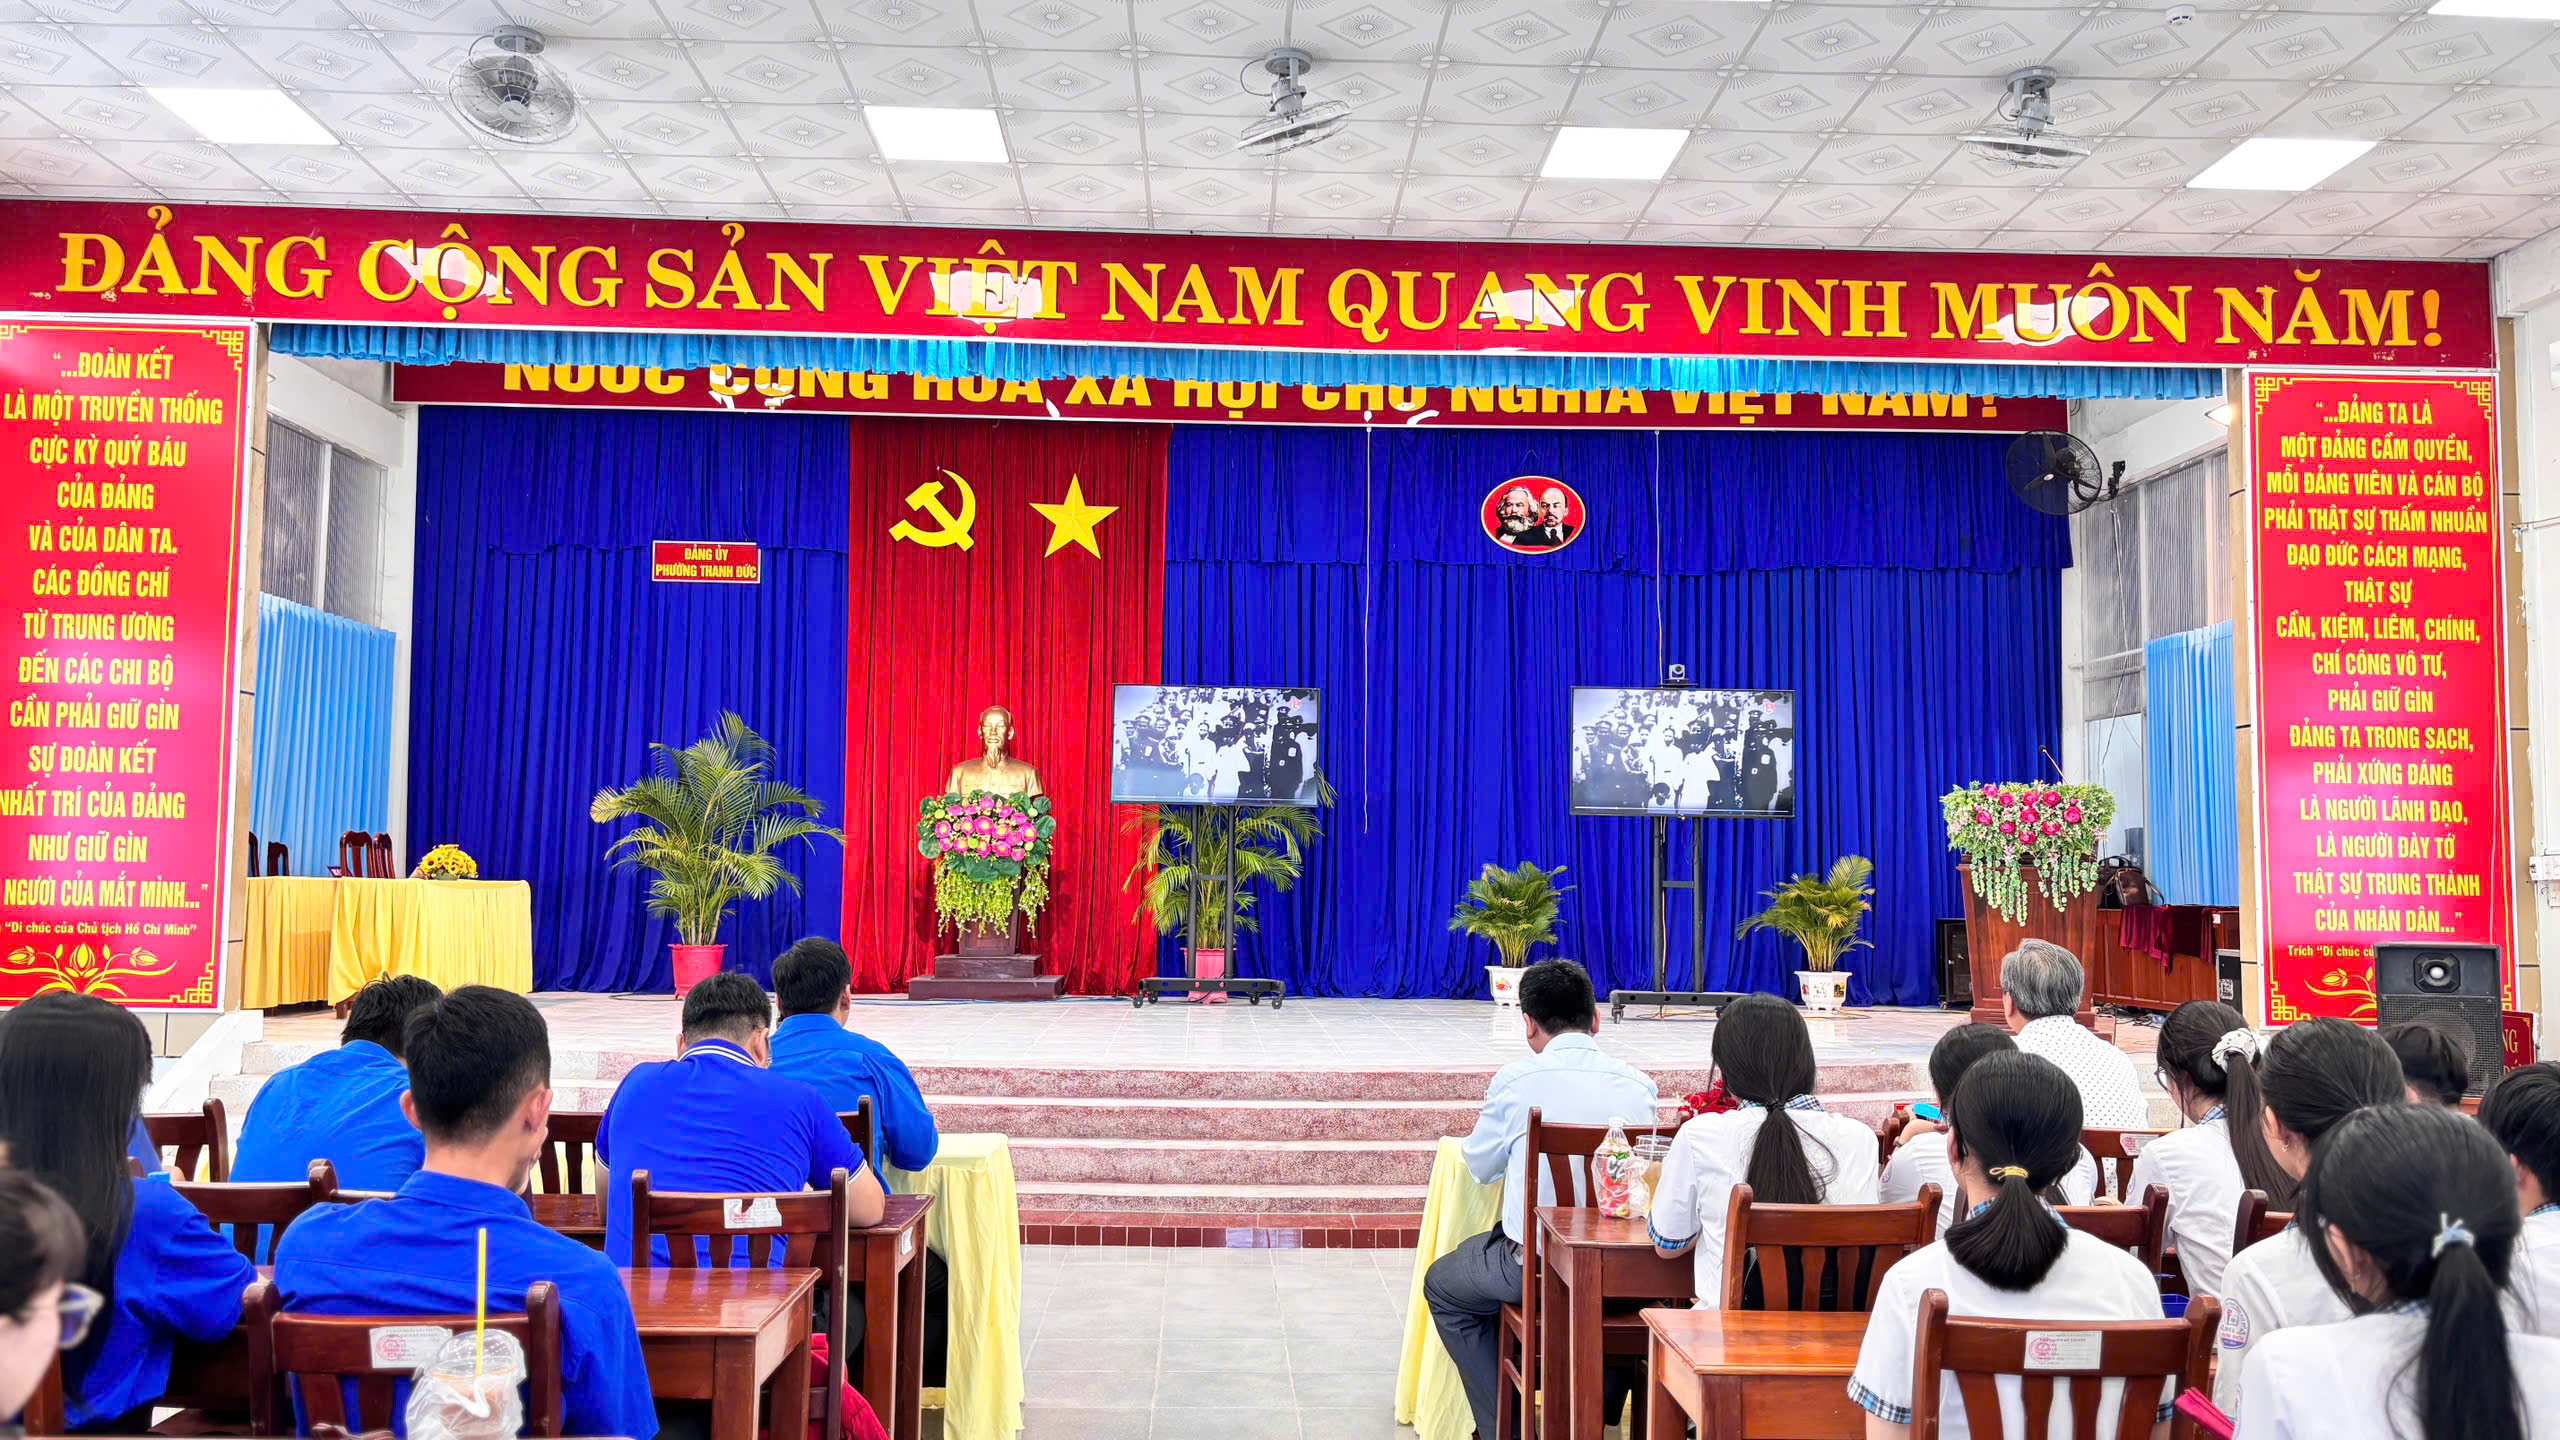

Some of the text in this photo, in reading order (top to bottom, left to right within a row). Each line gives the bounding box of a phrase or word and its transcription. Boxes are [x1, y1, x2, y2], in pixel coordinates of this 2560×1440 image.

[56, 205, 2442, 347] ĐẢNG CỘNG SẢN VIỆT NAM QUANG VINH MUÔN NĂM!
[136, 346, 173, 379] KẾT
[4, 389, 222, 426] LÀ MỘT TRUYỀN THỐNG
[2388, 403, 2408, 424] TA
[2413, 399, 2432, 424] LÀ
[30, 435, 68, 469] CỰC
[105, 435, 142, 468] QUÝ
[148, 436, 186, 466] BÁU
[2281, 430, 2472, 463] MỘT ĐẢNG CẦM QUYỀN,
[58, 473, 154, 509] CỦA ĐẢNG
[2267, 464, 2483, 501] MỖI ĐẢNG VIÊN VÀ CÁN BỘ
[2265, 500, 2487, 535] PHẢI THẬT SỰ THẤM NHUẦN
[30, 516, 177, 554] VÀ CỦA DÂN TA.
[684, 545, 728, 560] ĐẢNG ỦY
[2287, 542, 2466, 572] ĐẠO ĐỨC CÁCH MẠNG,
[34, 562, 169, 597] CÁC ĐỒNG CHÍ
[656, 562, 756, 578] PHƯỜNG THANH ĐỨC
[2344, 577, 2412, 608] THẬT SỰ
[24, 608, 174, 642] TỪ TRUNG ƯƠNG
[2277, 610, 2480, 643] CẦN, KIỆM, LIÊM, CHÍNH,
[19, 649, 173, 691] ĐẾN CÁC CHI BỘ
[2313, 649, 2446, 679] CHÍ CÔNG VÔ TƯ,
[11, 692, 179, 730] CẦN PHẢI GIỮ GÌN
[2328, 682, 2433, 712] PHẢI GIỮ GÌN
[2290, 718, 2473, 754] ĐẢNG TA TRONG SẠCH,
[29, 739, 156, 778] SỰ ĐOÀN KẾT
[2314, 755, 2452, 786] PHẢI XỨNG ĐÁNG
[0, 782, 185, 819] NHẤT TRÍ CỦA ĐẢNG
[2301, 794, 2468, 827] LÀ NGƯỜI LÃNH ĐẠO,
[29, 831, 147, 862] NHƯ GIỮ GÌN
[2317, 831, 2337, 857] LÀ
[2342, 834, 2393, 858] NGƯỜI
[2434, 834, 2455, 859] TỚ
[4, 876, 56, 906] NGƯƠI
[61, 870, 94, 906] CỦA
[99, 871, 136, 907] MẮT
[2293, 868, 2480, 899] THẬT SỰ TRUNG THÀNH
[26, 922, 51, 933] chúc
[55, 921, 74, 933] của
[77, 921, 98, 934] Chủ
[102, 923, 121, 936] tịch
[144, 924, 160, 934] Chí
[2316, 902, 2349, 931] CỦA
[2354, 908, 2400, 931] NHÂN
[2288, 945, 2313, 956] Trích
[2336, 946, 2360, 956] chúc
